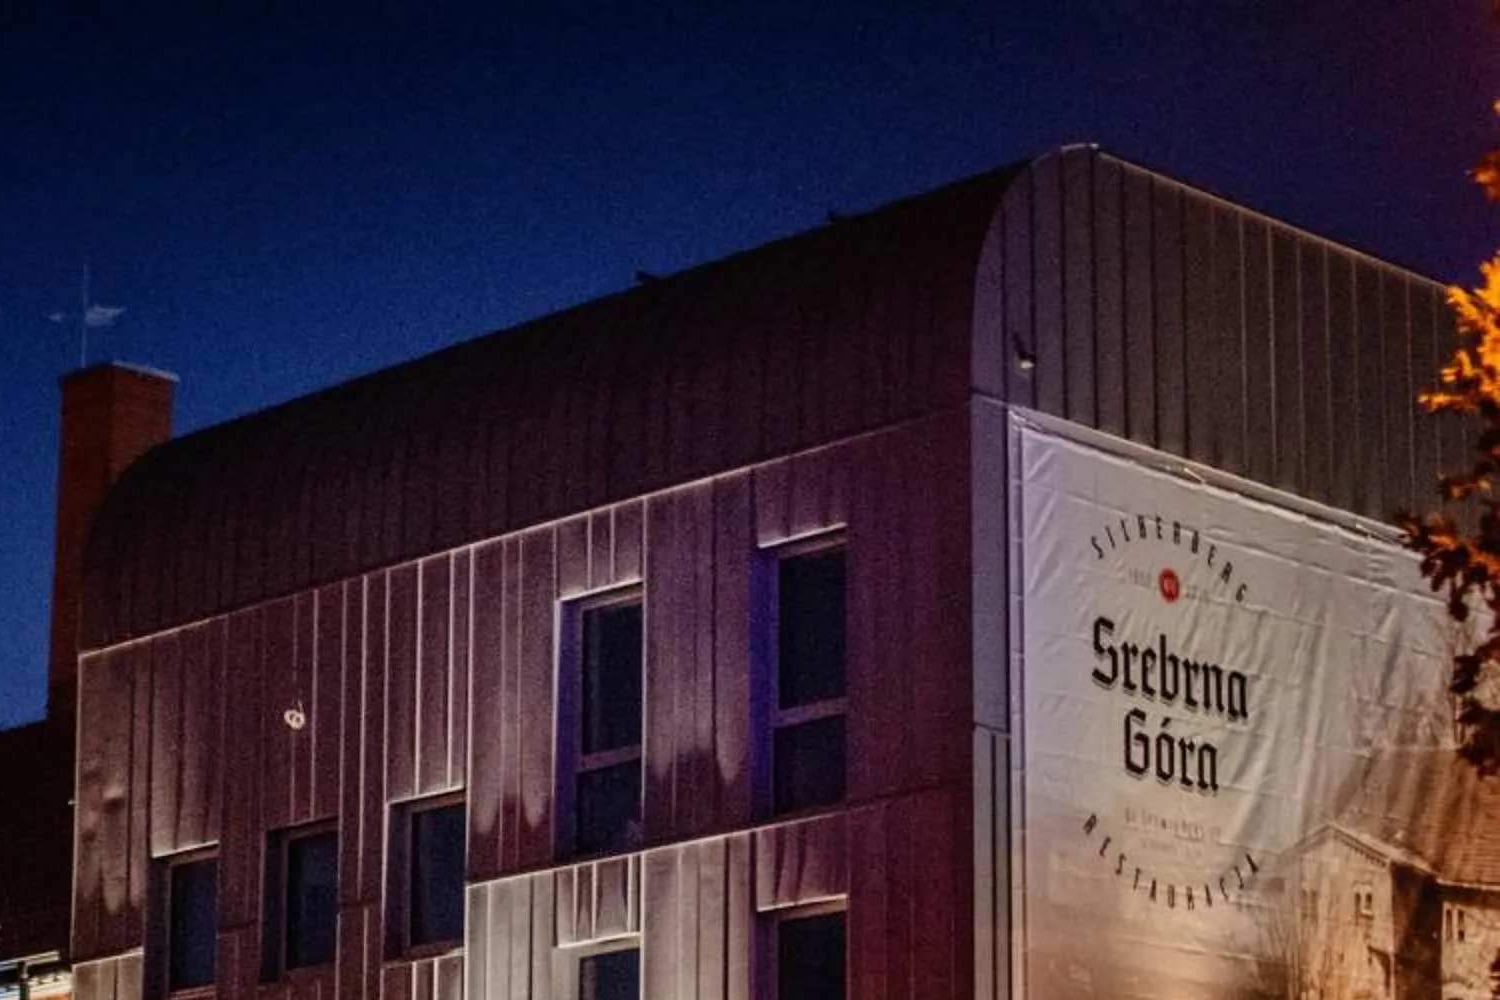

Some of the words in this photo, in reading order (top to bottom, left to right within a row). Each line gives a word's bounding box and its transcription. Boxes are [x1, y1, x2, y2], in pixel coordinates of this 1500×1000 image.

[1090, 514, 1248, 603] SILBERBERG
[1091, 616, 1249, 720] Srebrna
[1123, 706, 1220, 792] Góra
[1083, 812, 1259, 911] RESTAURACJA
